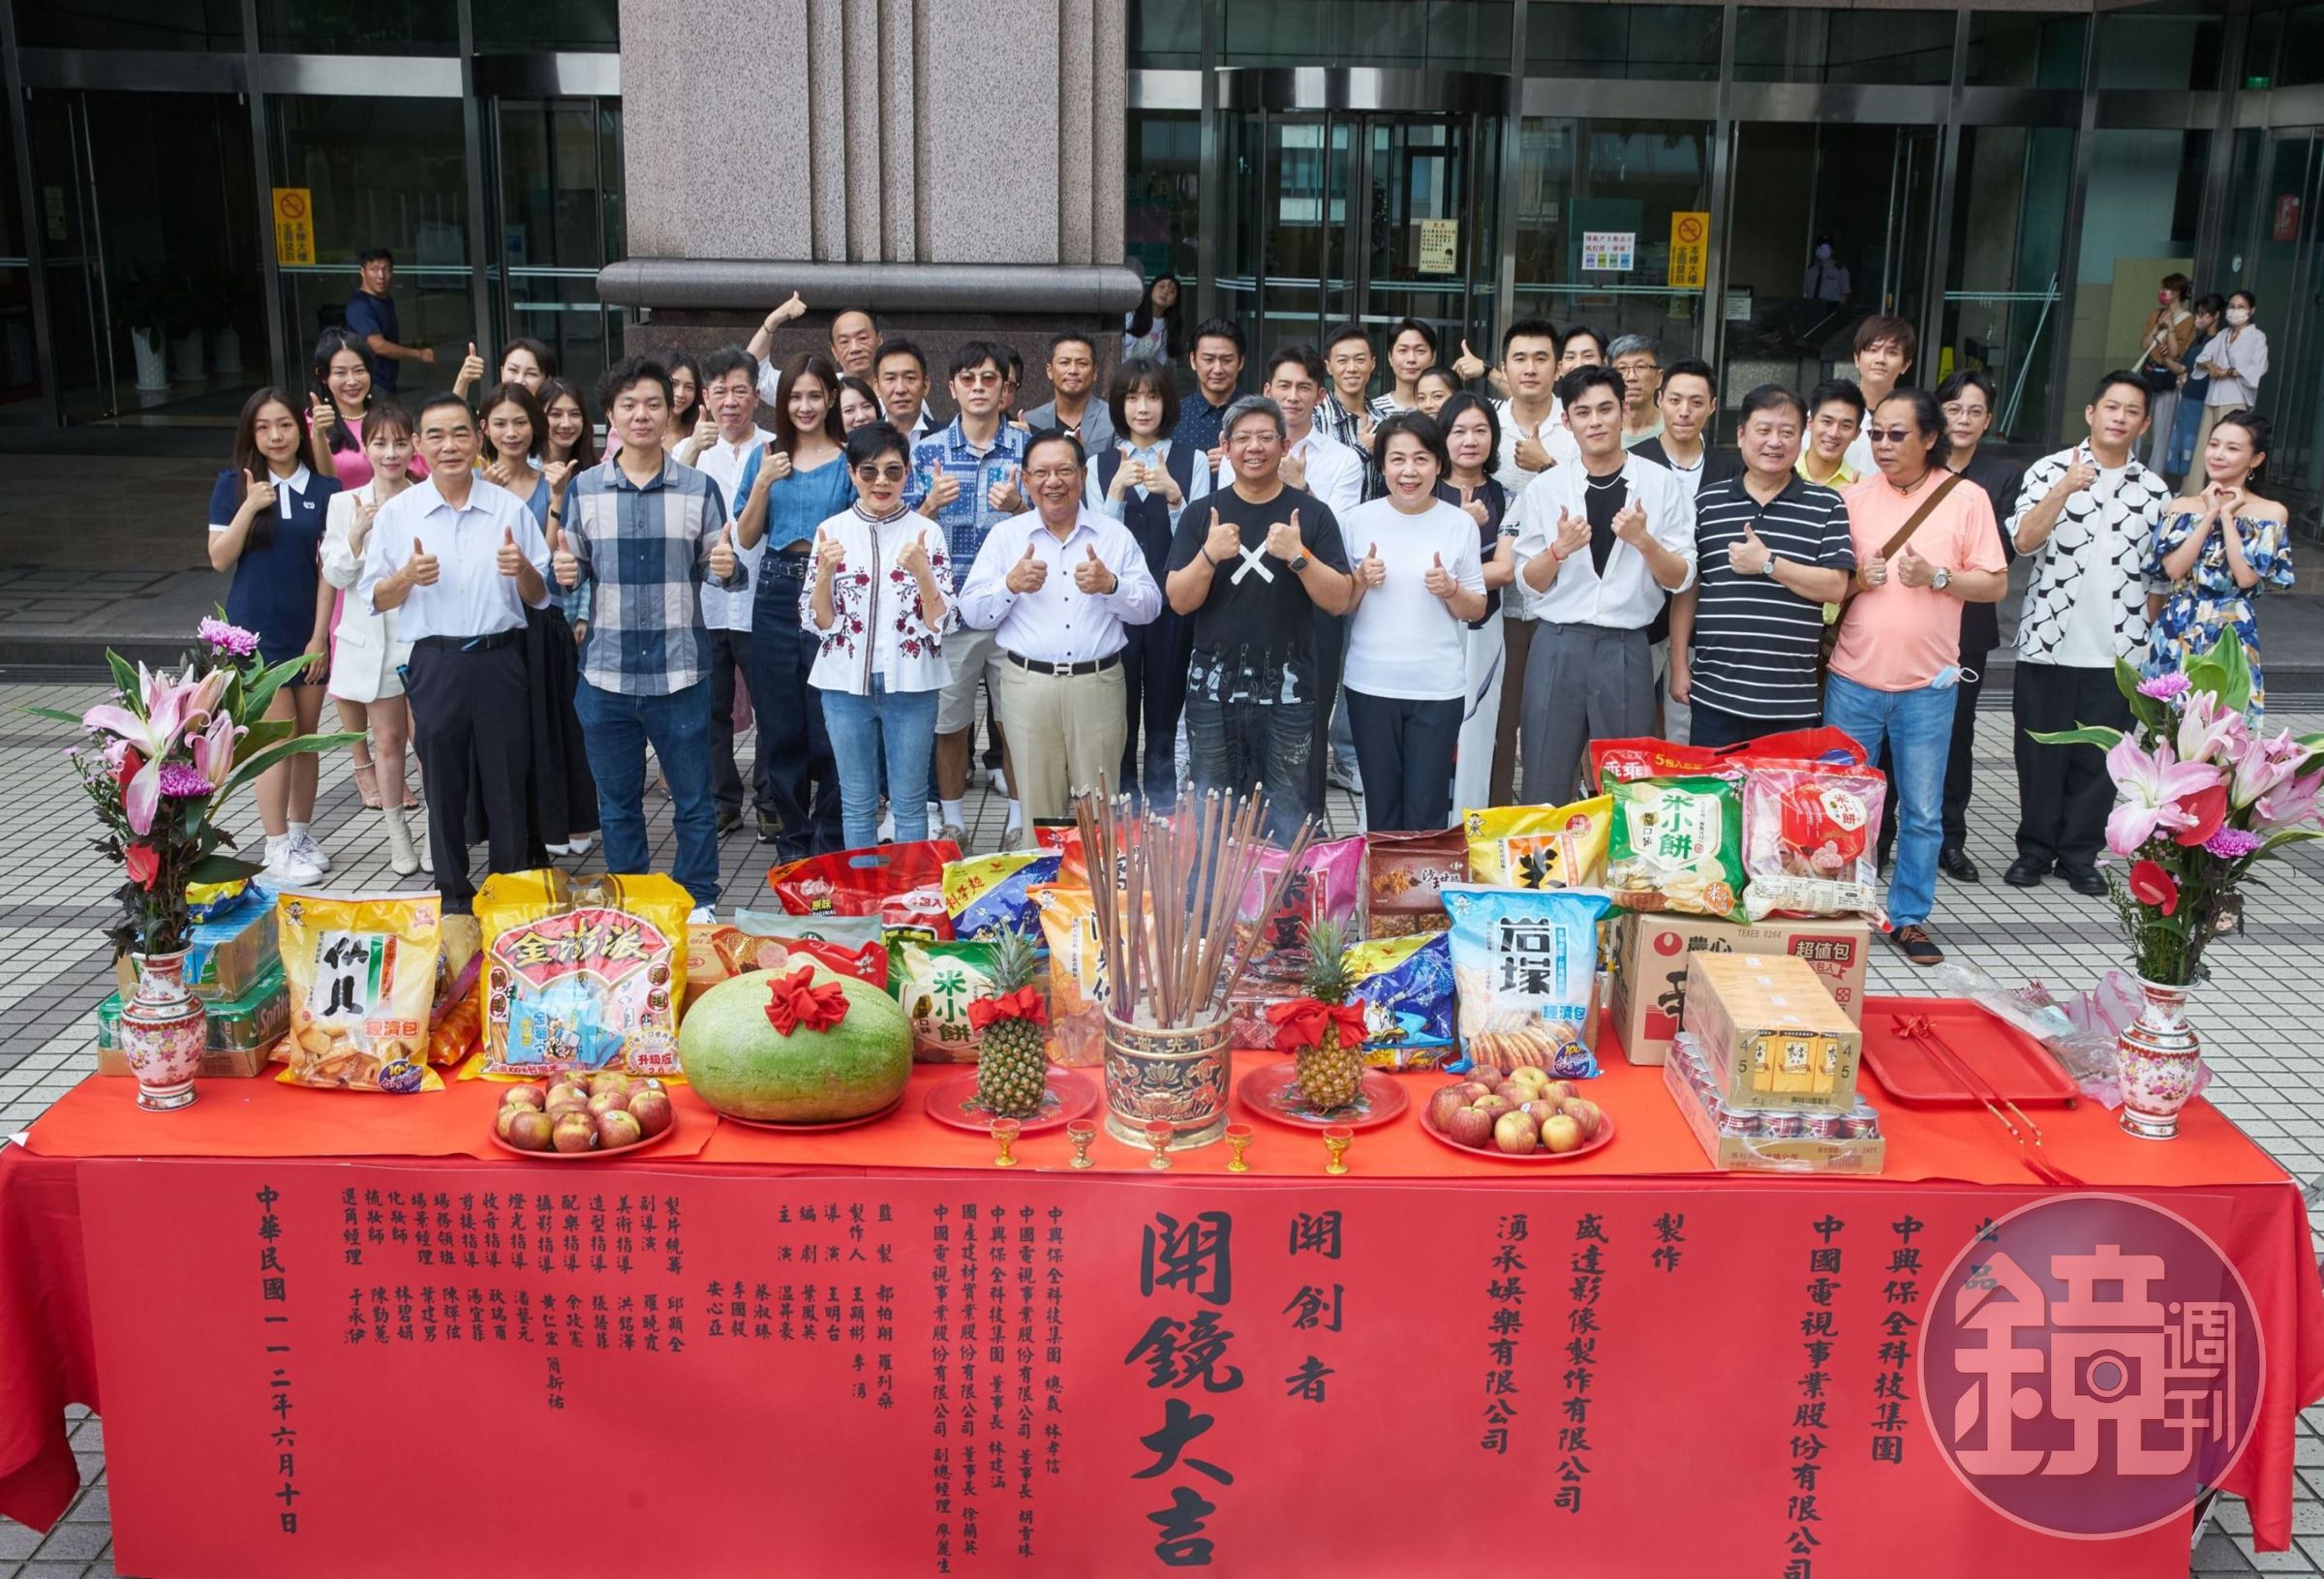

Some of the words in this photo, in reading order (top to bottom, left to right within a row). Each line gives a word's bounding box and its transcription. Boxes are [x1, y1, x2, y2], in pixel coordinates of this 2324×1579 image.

[1603, 760, 1644, 781] 乖乖
[1658, 794, 1696, 861] 米小餅
[1834, 794, 1857, 826] 米小餅
[1499, 917, 1551, 995] 岩塚
[1795, 939, 1851, 961] 超值包
[933, 969, 972, 1043] 米小餅
[1543, 1004, 1586, 1021] 經濟包
[1737, 1059, 1748, 1074] 5
[1739, 1039, 1750, 1052] 4
[1841, 1065, 1850, 1079] 5
[1843, 1045, 1852, 1058] 4
[343, 1187, 362, 1266] 選角經理
[387, 1191, 409, 1244] 化妝師
[411, 1192, 433, 1265] 場景經理
[433, 1192, 455, 1265] 場務領班
[460, 1193, 479, 1268] 剪接指導
[482, 1192, 501, 1268] 收音指導
[507, 1193, 527, 1270] 燈光指導
[535, 1194, 554, 1274] 攝影指導
[561, 1195, 580, 1273] 配樂指導
[589, 1194, 607, 1273] 造型指導
[615, 1195, 633, 1275] 美術指導
[639, 1195, 657, 1251] 副導演
[849, 1202, 866, 1261] 製作人
[1651, 1212, 1685, 1273] 製作
[706, 1280, 724, 1337] 安心亞
[730, 1280, 748, 1338] 李國毅
[754, 1283, 772, 1340] 蔡淑臻
[932, 1203, 950, 1438] 中國電視事業股份有限公司
[960, 1203, 978, 1438] 國產建材實業股份有限公司
[989, 1204, 1007, 1364] 中興保全科技集團
[1046, 1205, 1064, 1364] 中興保全科技集團
[1282, 1209, 1345, 1404] 開創者
[1017, 1204, 1036, 1440] 中國電視事業股份有限公司
[1481, 1213, 1529, 1455] 湧承娛樂有限公司
[1871, 1214, 1926, 1465] 中興保全科技集團
[255, 1184, 300, 1534] 中華民國一一二年六月十日
[1123, 1210, 1244, 1567] 開鏡大吉
[1553, 1212, 1609, 1514] 盛達影像製作有限公司
[990, 1375, 1004, 1430] 董事長
[1783, 1213, 1846, 1579] 中國電視事業股份有限公司
[933, 1447, 951, 1514] 副總經理
[963, 1445, 976, 1496] 董事長
[1019, 1448, 1032, 1499] 董事長
